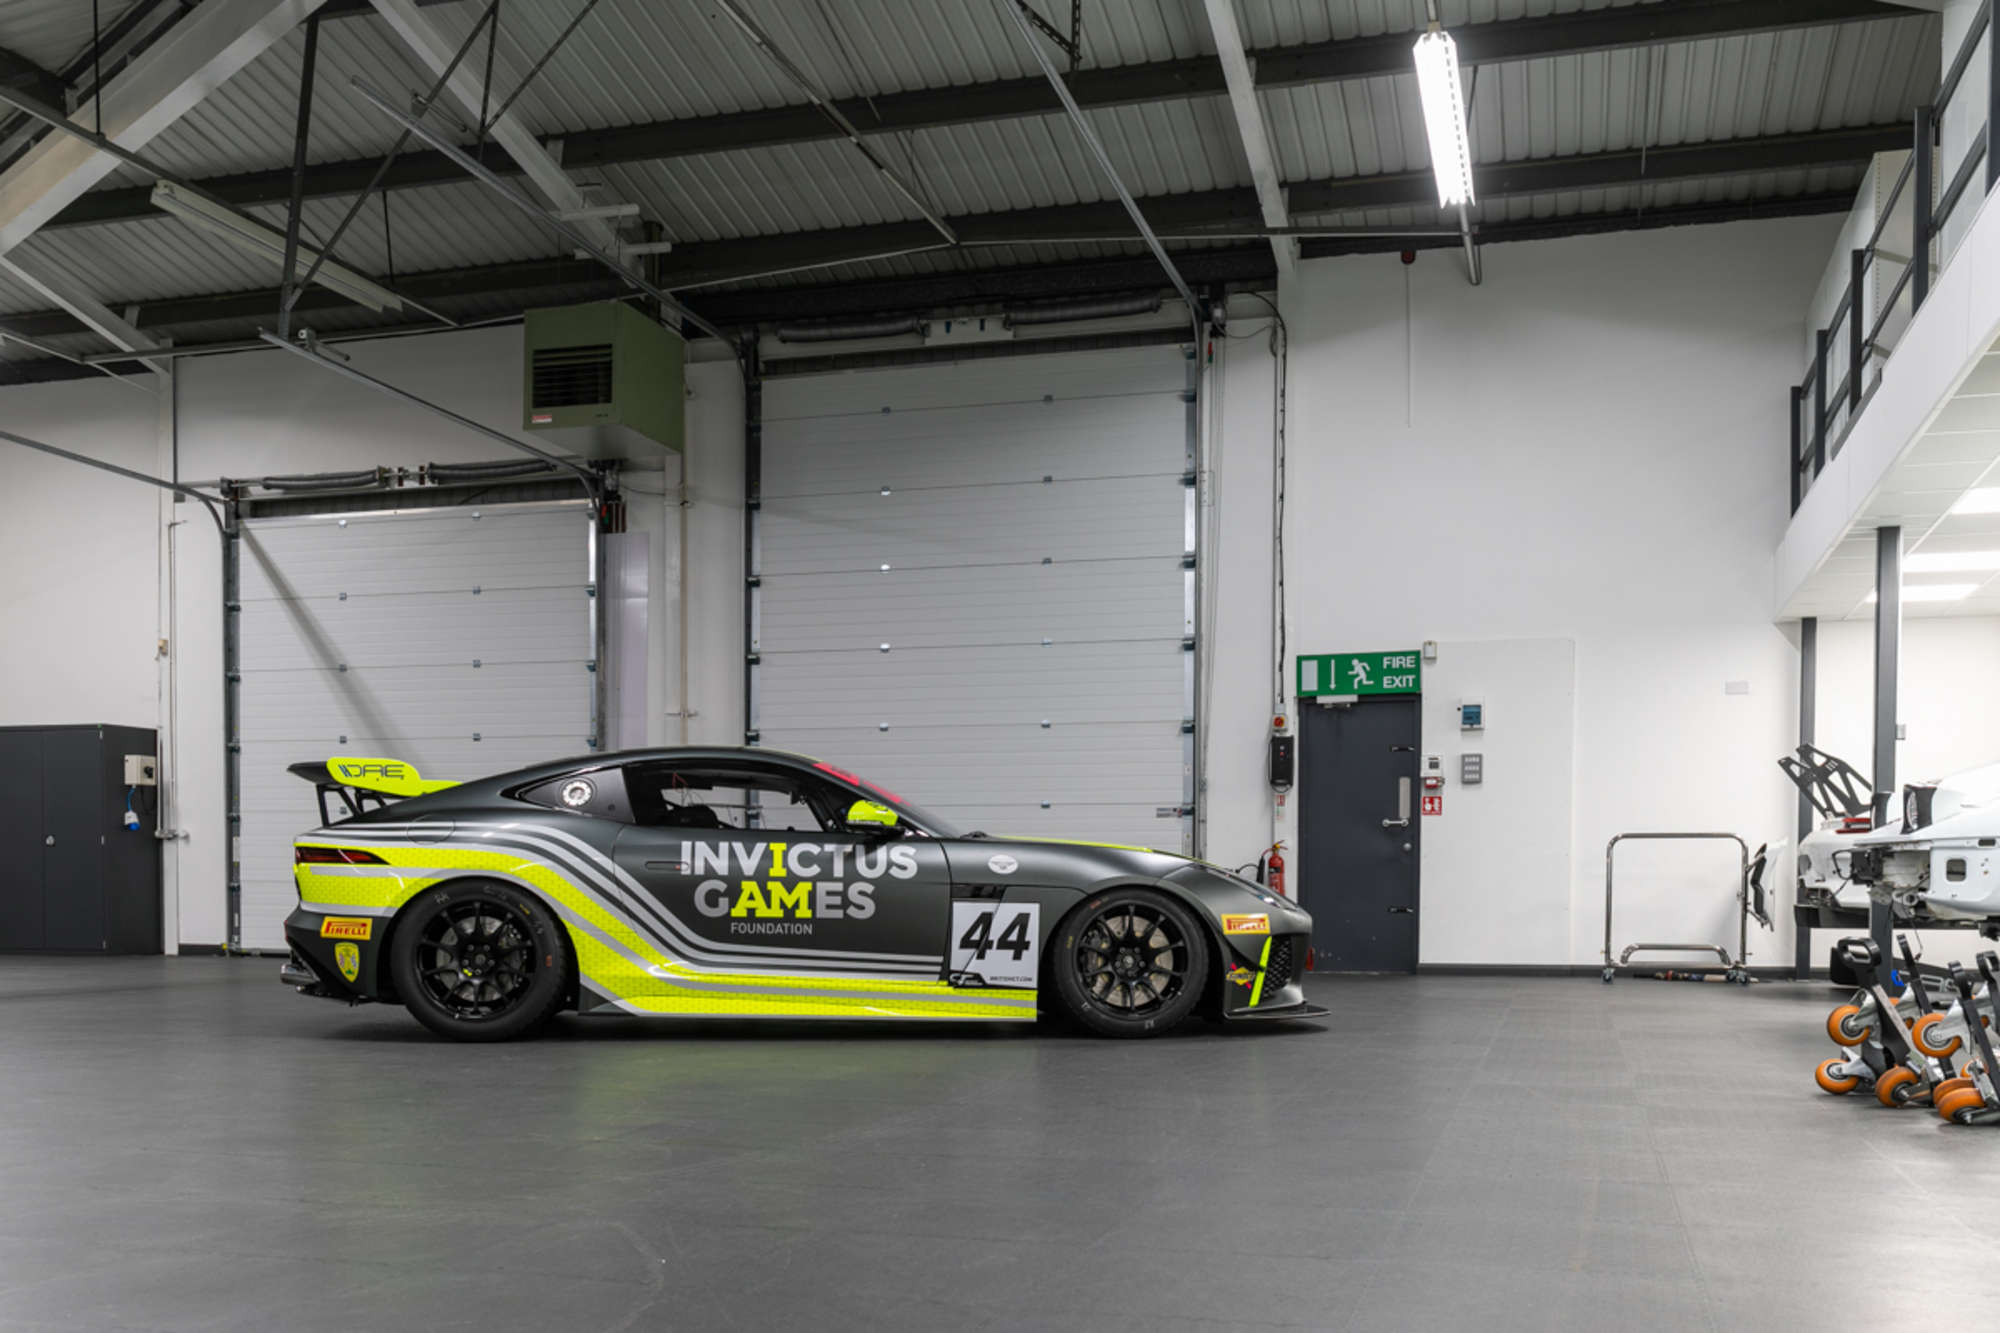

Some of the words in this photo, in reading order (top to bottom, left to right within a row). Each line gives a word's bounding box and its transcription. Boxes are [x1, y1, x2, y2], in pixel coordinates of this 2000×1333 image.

[1383, 655, 1416, 669] FIRE
[1383, 675, 1416, 688] EXIT
[680, 841, 919, 880] INVICTUS
[694, 879, 876, 920] GAMES
[731, 922, 813, 935] FOUNDATION
[959, 911, 1031, 961] 44
